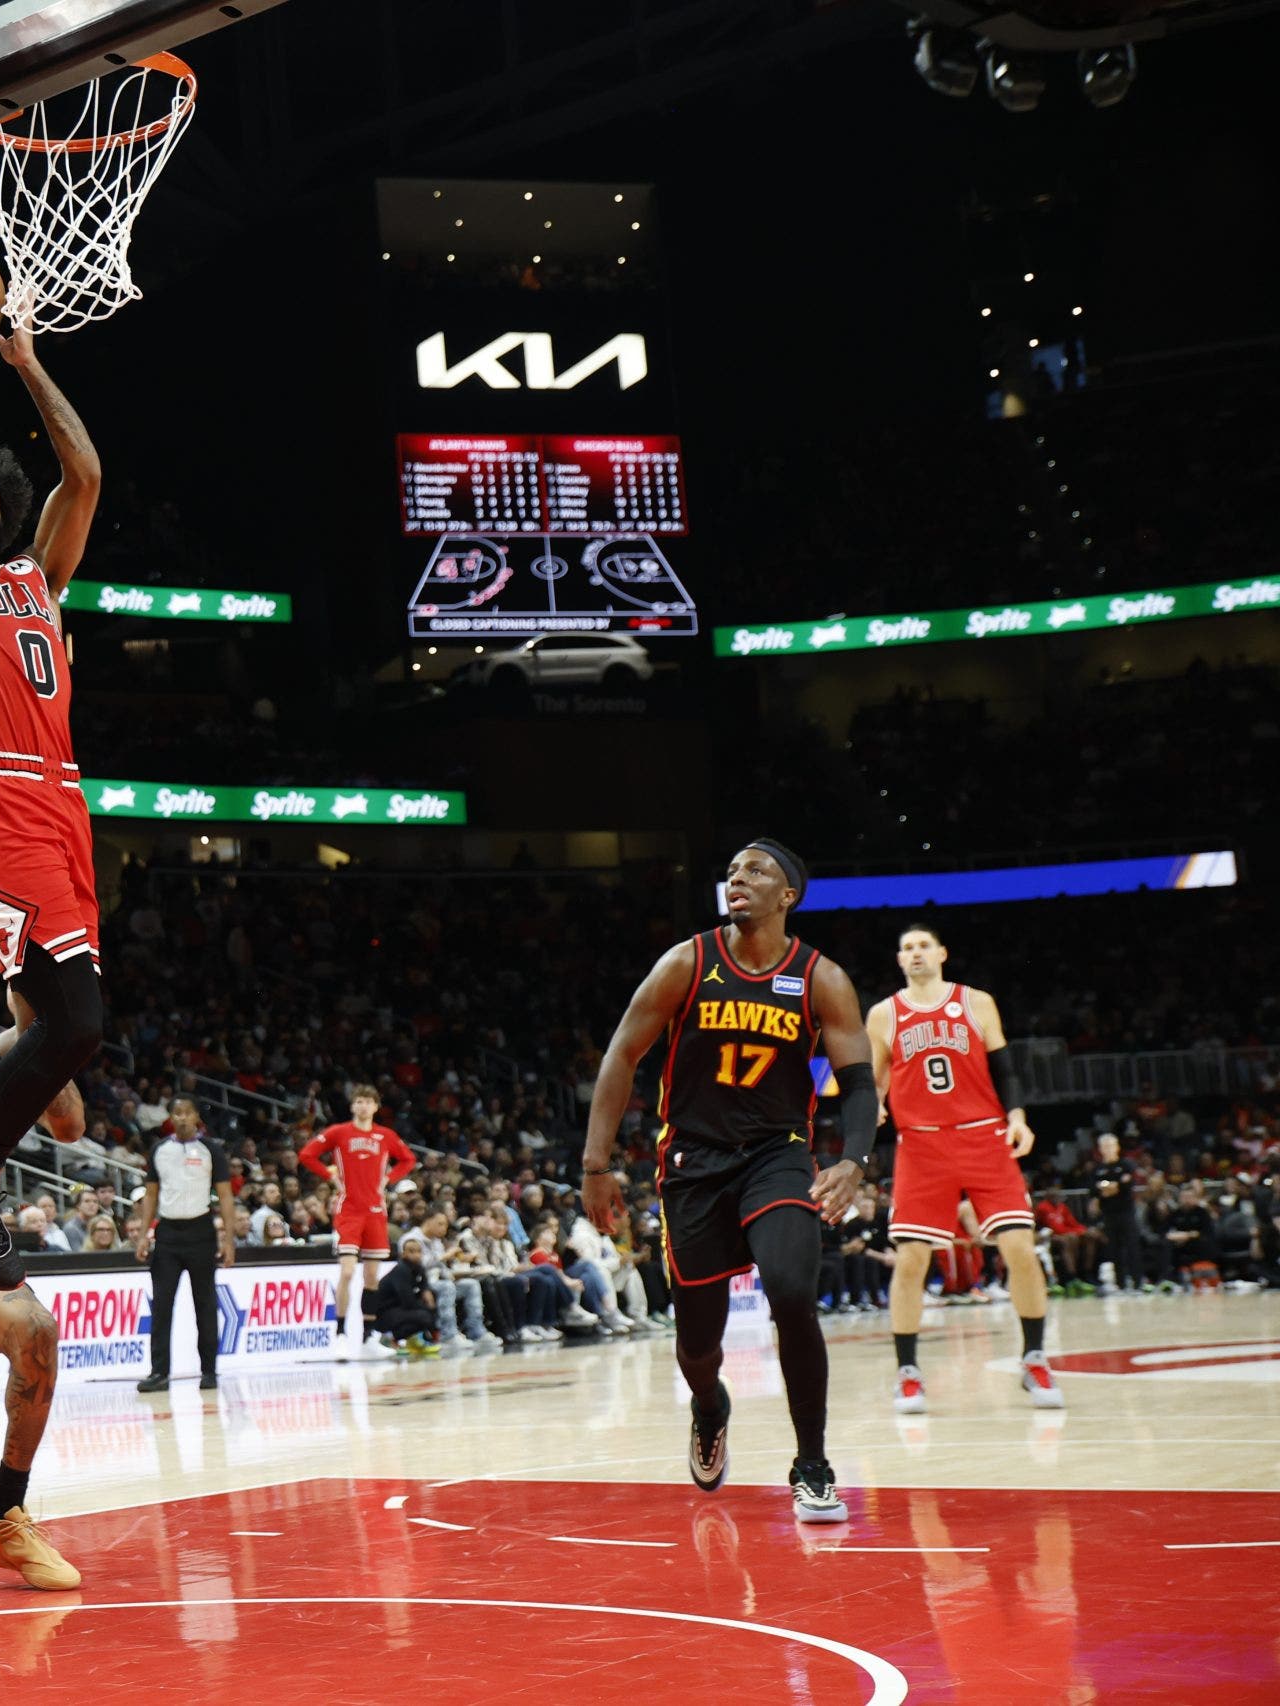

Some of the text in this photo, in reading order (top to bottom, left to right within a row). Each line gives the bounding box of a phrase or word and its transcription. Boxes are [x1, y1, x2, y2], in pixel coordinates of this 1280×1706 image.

[98, 586, 153, 612] Sprite
[218, 594, 276, 620] Sprite
[732, 628, 794, 655] Sprite
[866, 617, 930, 645] Sprite
[966, 609, 1031, 637] Sprite
[1107, 594, 1175, 624] Sprite
[15, 629, 58, 700] 0
[154, 788, 215, 817] Sprite
[251, 791, 316, 820] Sprite
[387, 794, 449, 822] Sprite
[698, 1000, 801, 1042] HAWKS
[898, 1020, 970, 1063] BULLS
[716, 1043, 778, 1088] 17
[923, 1053, 955, 1095] 9
[52, 1288, 143, 1340] ARROW
[248, 1279, 328, 1328] ARROW
[58, 1341, 144, 1369] TERMINATORS
[246, 1326, 330, 1353] EXTERMINATORS
